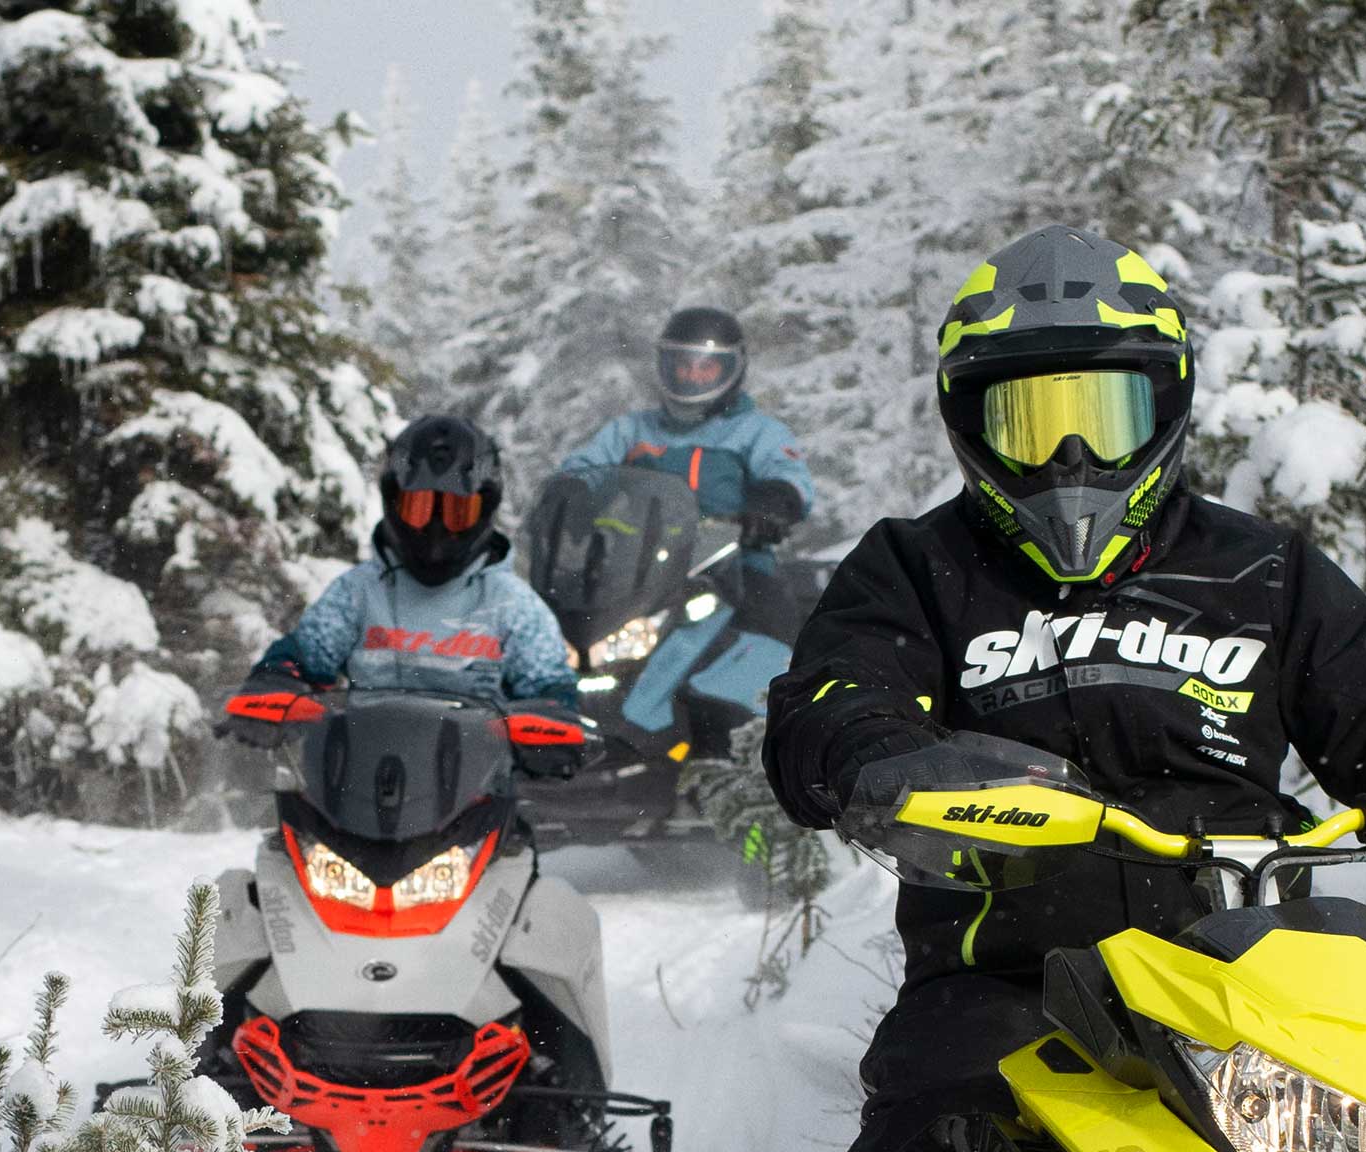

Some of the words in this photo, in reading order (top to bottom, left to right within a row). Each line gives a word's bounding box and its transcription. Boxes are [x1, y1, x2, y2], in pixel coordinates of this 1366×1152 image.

[980, 667, 1103, 711] RACING
[1191, 683, 1239, 709] ROTAX
[942, 804, 1051, 828] ski-doo
